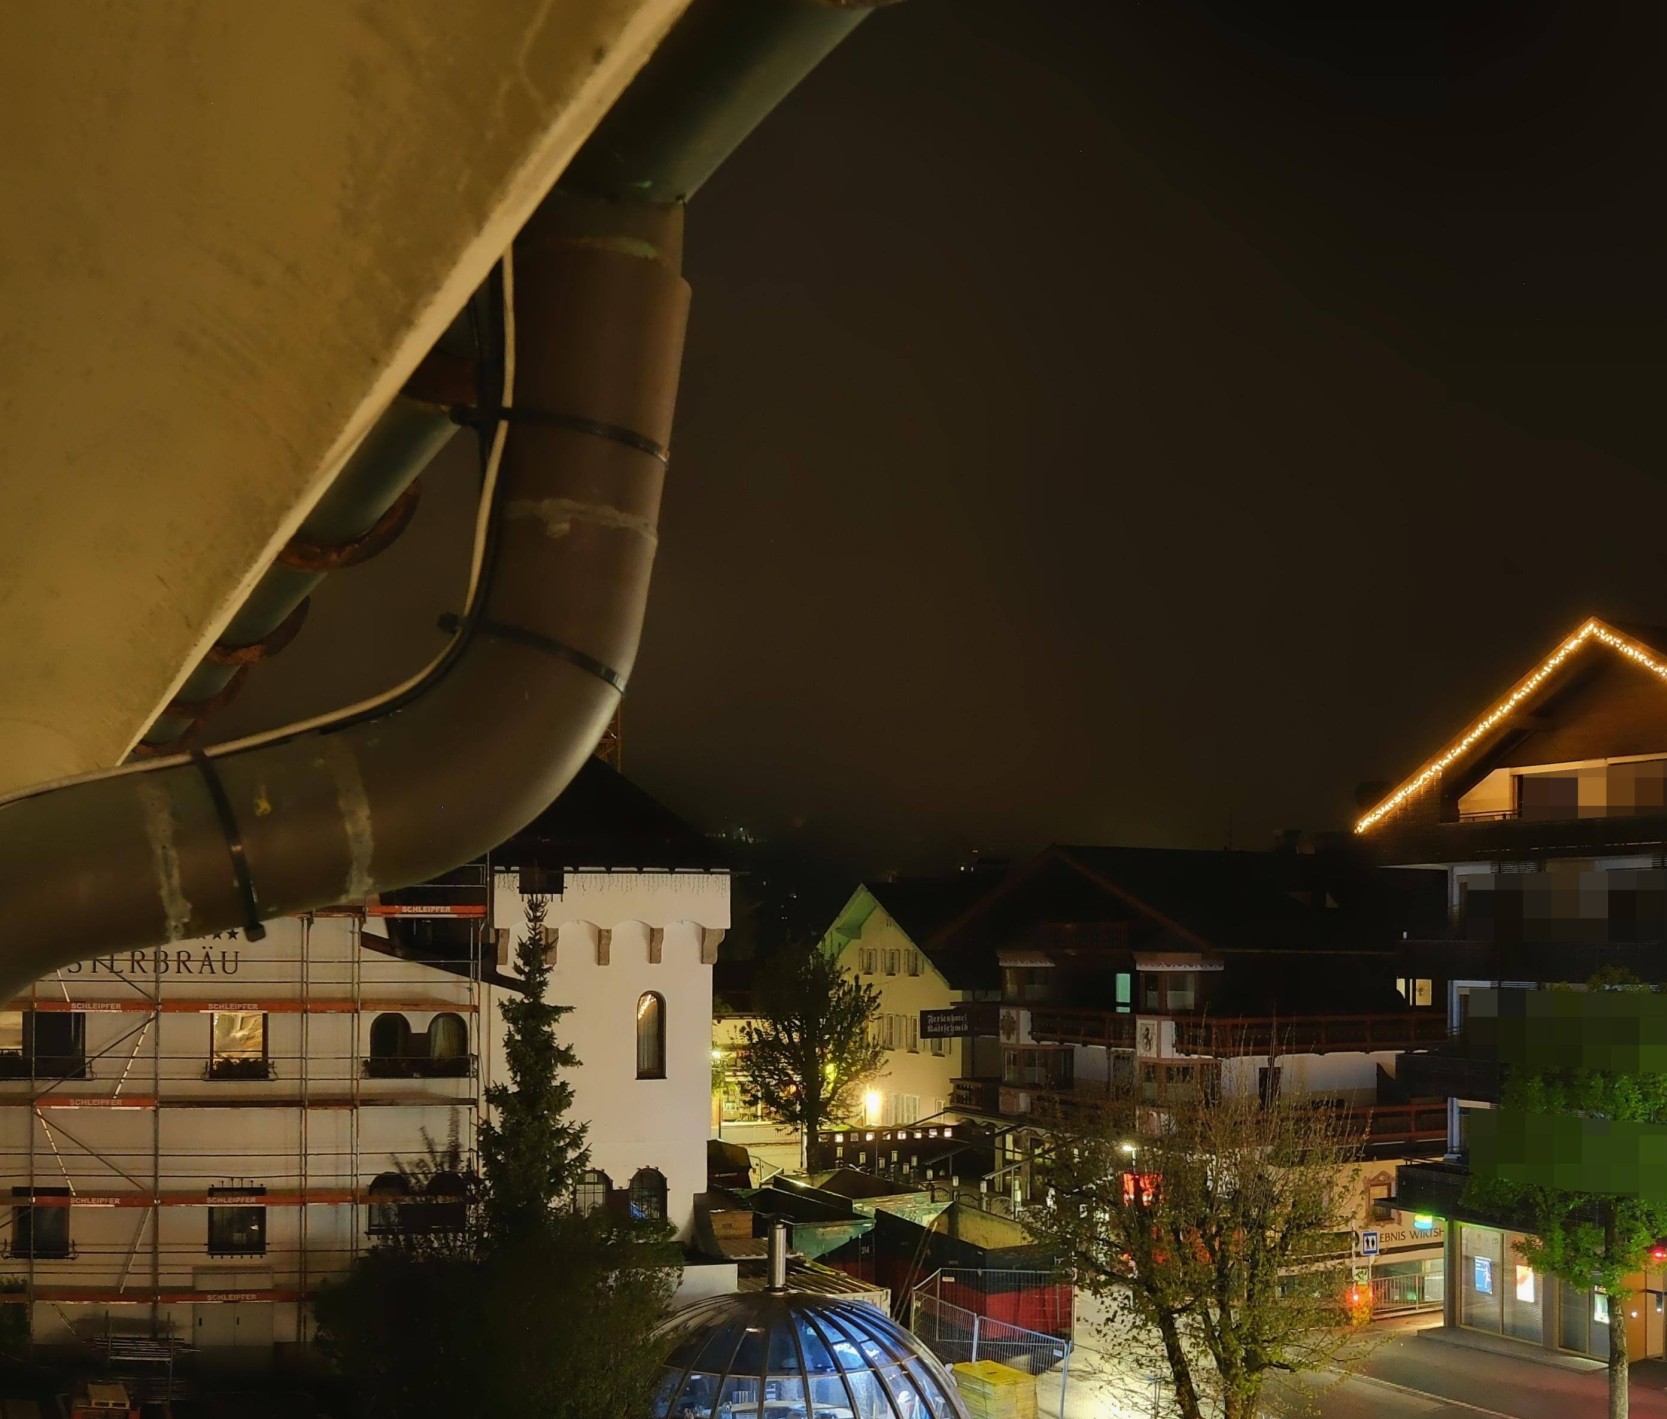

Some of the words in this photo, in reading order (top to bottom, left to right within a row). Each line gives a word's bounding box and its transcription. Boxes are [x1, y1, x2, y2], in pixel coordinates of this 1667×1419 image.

[402, 905, 451, 914] SCHLEIPFER
[70, 1002, 122, 1011] SCHLEIPFER
[207, 1003, 259, 1011] SCHLEIPFER
[69, 1099, 123, 1107] SCHLEIPFER
[69, 1197, 121, 1205] SCHLEIPFER
[206, 1196, 257, 1204] SCHLEIPFER
[206, 1293, 258, 1301] SCHLEIPFER
